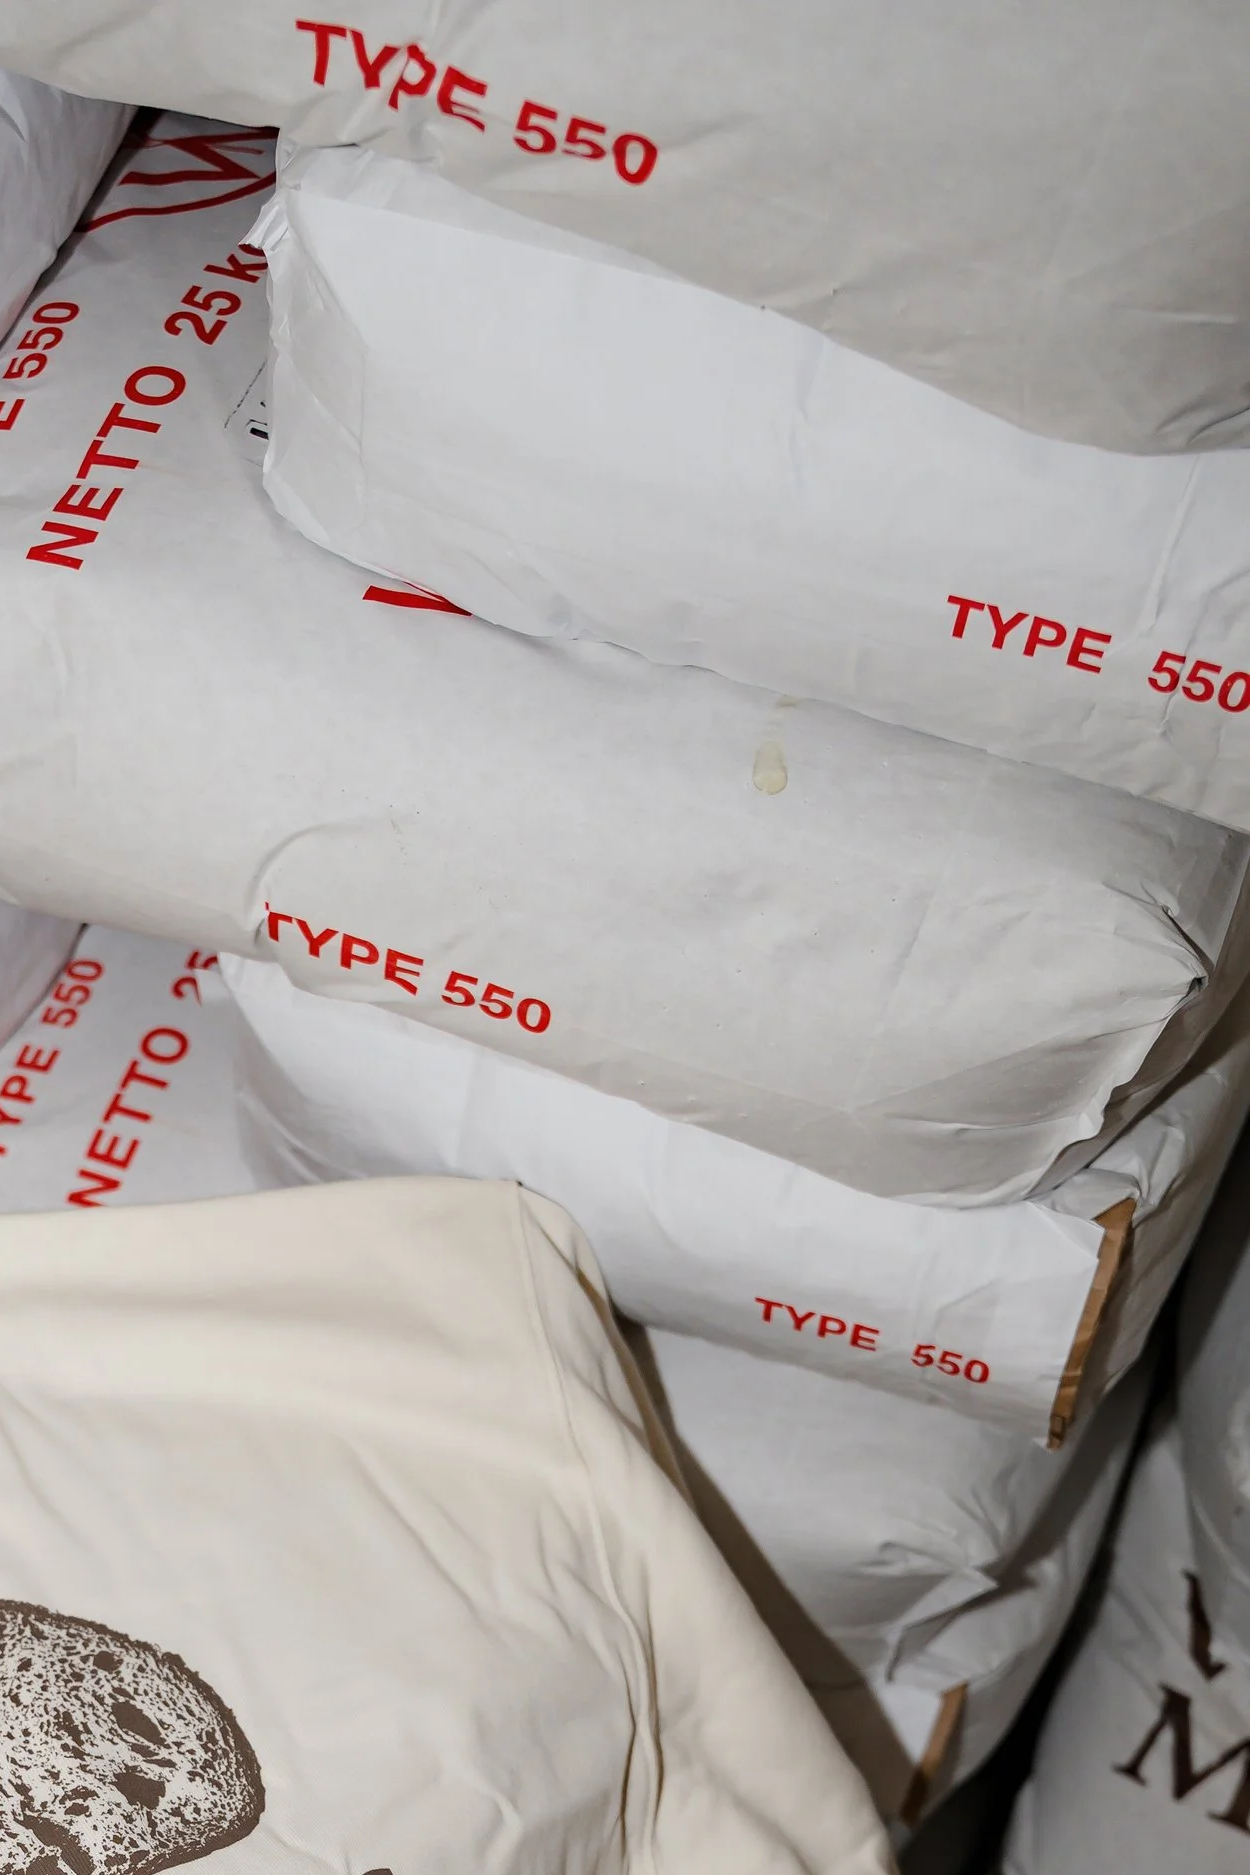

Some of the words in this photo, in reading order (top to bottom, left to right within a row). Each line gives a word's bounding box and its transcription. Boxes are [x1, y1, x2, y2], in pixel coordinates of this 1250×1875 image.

[295, 19, 488, 132] TYPE
[513, 100, 659, 185] 550
[5, 302, 79, 380] 550
[26, 365, 187, 571] NETTO
[163, 286, 242, 345] 25
[204, 243, 268, 284] k
[947, 595, 1112, 674] TYPE
[1148, 650, 1250, 713] 550
[43, 960, 104, 1028] 550
[264, 901, 424, 996] TYPE
[441, 970, 552, 1034] 550
[66, 1026, 190, 1208] NETTO
[755, 1297, 879, 1352] TYPE
[912, 1344, 990, 1384] 550
